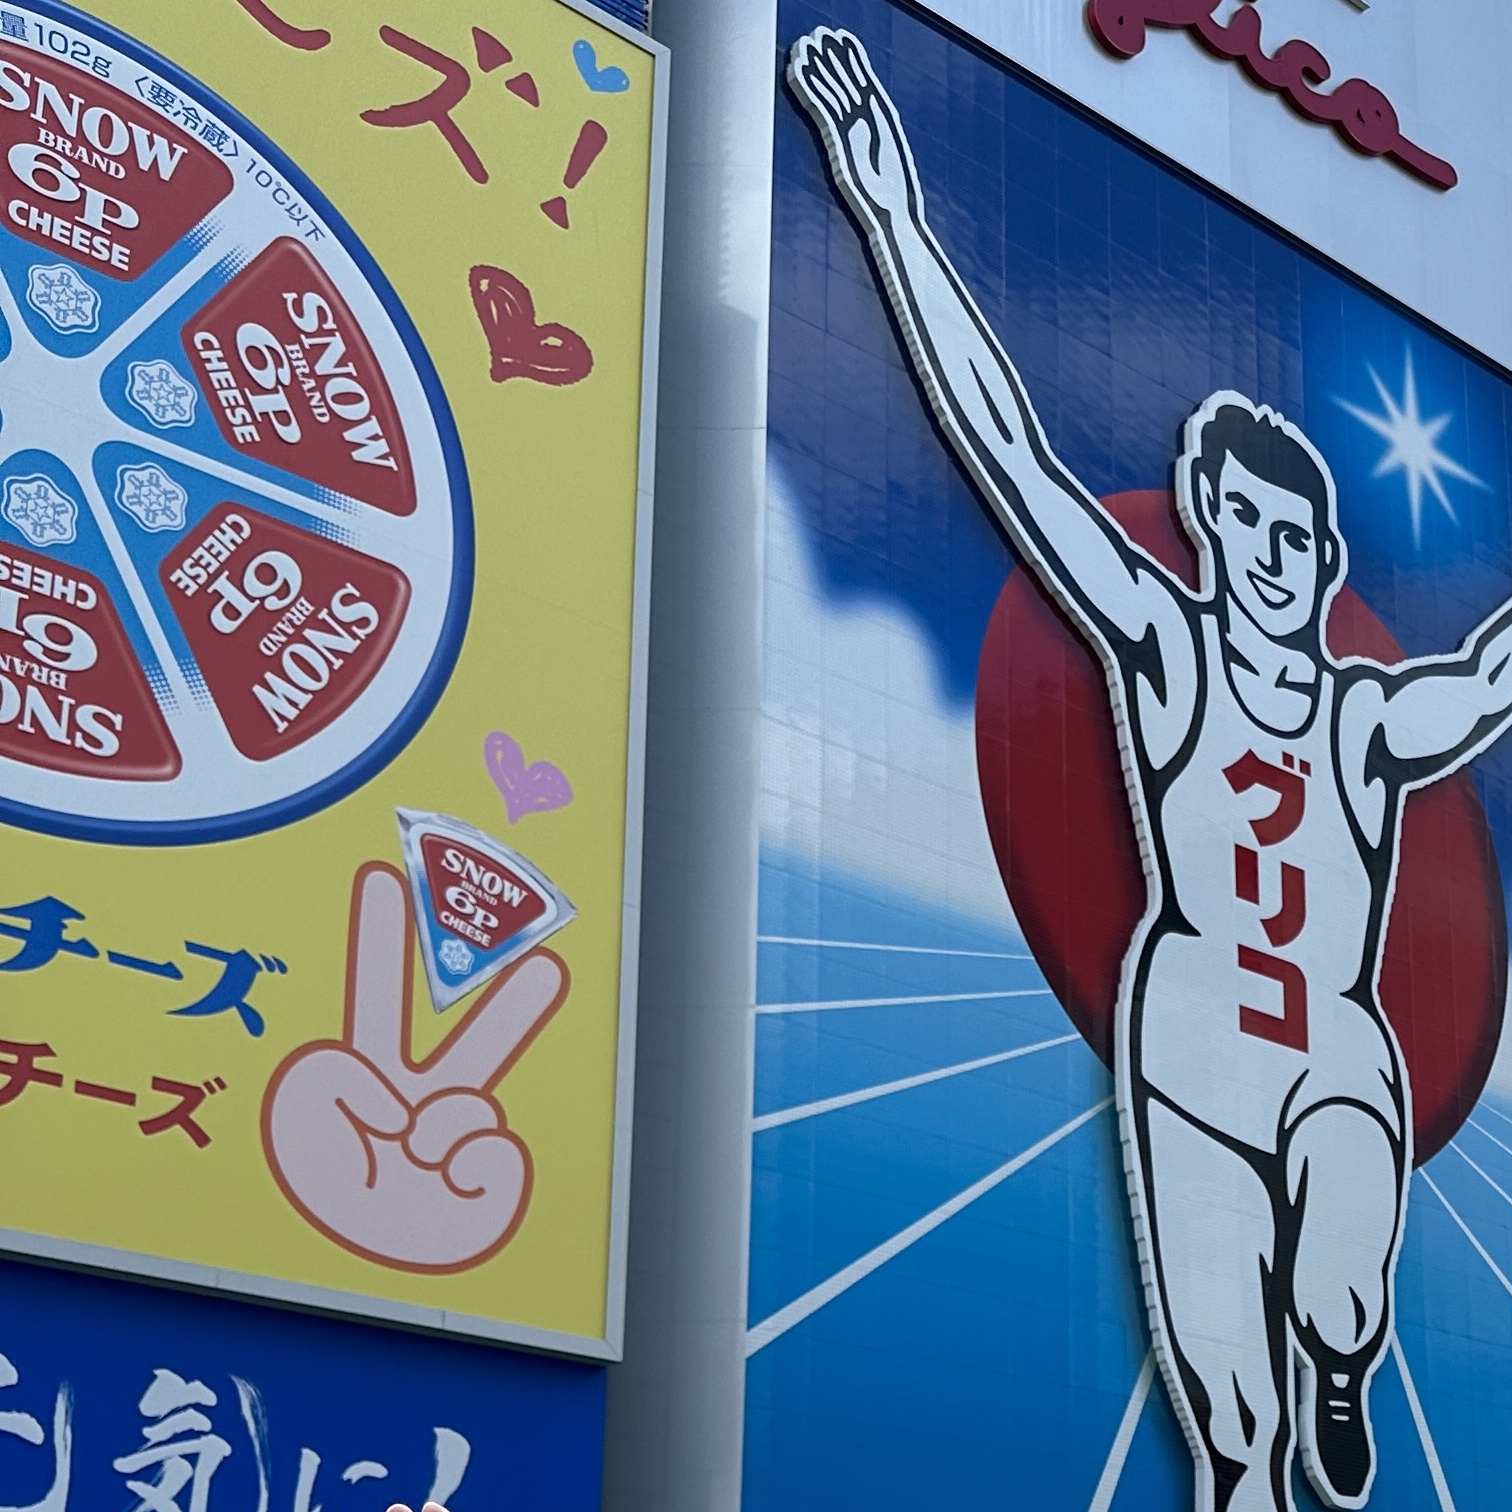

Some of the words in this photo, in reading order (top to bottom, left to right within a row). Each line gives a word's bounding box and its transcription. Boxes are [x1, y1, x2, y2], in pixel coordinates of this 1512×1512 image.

[0, 59, 188, 182] SNOW
[36, 127, 126, 180] BRAND
[8, 142, 140, 235] 6P
[8, 199, 130, 271] CHEESE
[193, 330, 262, 444] CHEESE
[236, 322, 302, 444] 6P
[281, 290, 398, 473] SNOW
[285, 343, 331, 424] BRAND
[169, 513, 252, 597] CHEESE
[207, 549, 302, 634] 6P
[252, 582, 379, 733] SNOW
[258, 596, 315, 657] BRAND
[441, 848, 528, 909] SNOW
[445, 885, 499, 929] 6P
[460, 880, 498, 906] BRAND
[1221, 748, 1312, 1054] グリコ
[440, 910, 492, 947] CHEESE
